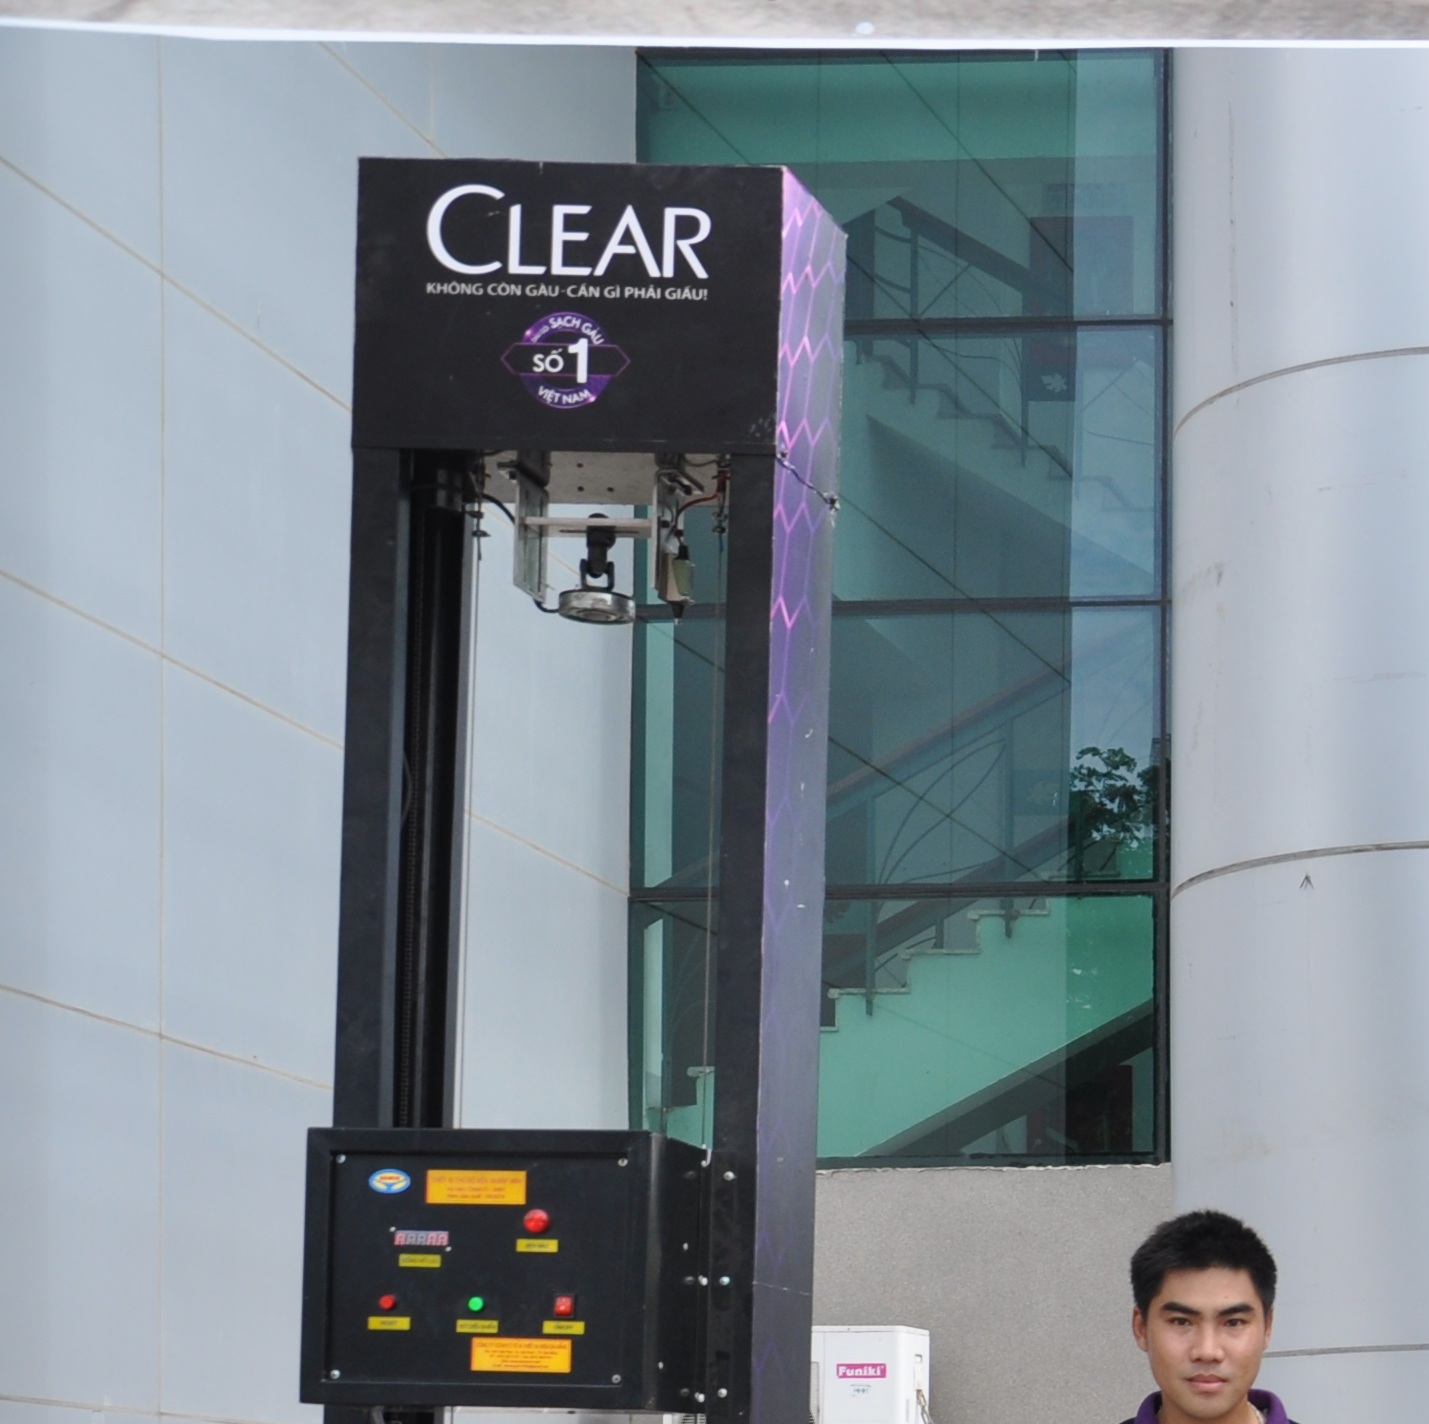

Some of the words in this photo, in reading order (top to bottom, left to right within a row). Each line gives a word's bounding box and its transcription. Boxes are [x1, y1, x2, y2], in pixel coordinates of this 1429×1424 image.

[426, 183, 712, 279] CLEAR
[426, 280, 484, 296] KHÔNG
[487, 281, 522, 297] CÒN
[532, 348, 564, 373] SỐ
[567, 337, 588, 384] 1
[838, 1365, 882, 1377] Funiki
